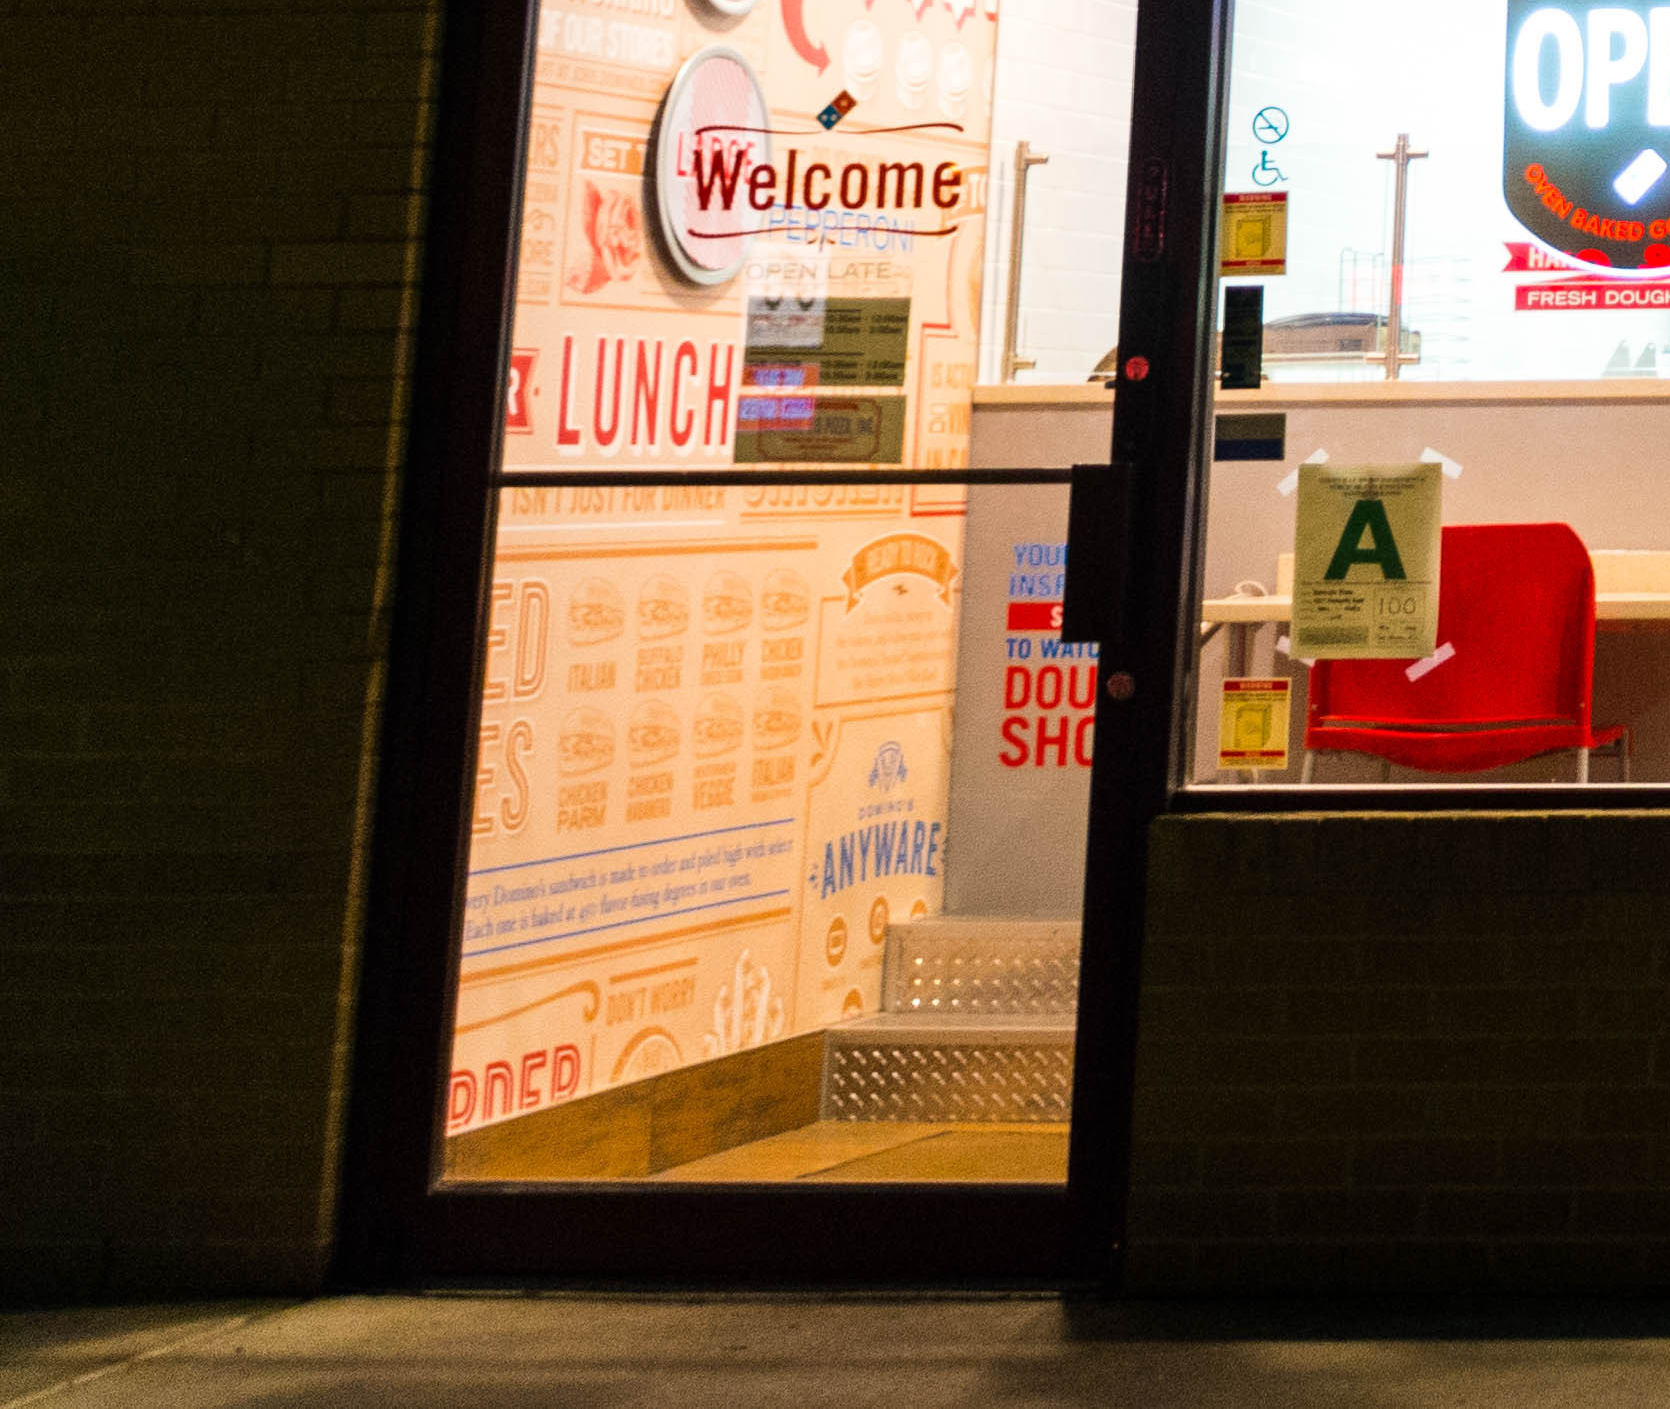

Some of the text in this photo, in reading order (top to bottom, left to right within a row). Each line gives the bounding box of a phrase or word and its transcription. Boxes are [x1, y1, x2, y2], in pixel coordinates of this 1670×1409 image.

[588, 140, 632, 173] SET
[694, 148, 963, 212] Welcome
[1523, 162, 1573, 220] OVEN
[1569, 205, 1645, 243] BAKED
[767, 203, 914, 253] PEPPERONI
[746, 261, 891, 280] OPEN LATE
[1527, 291, 1598, 306] FRESH
[556, 335, 735, 448] LUNCH
[1322, 499, 1408, 581] A
[1379, 596, 1418, 616] 100
[1006, 637, 1099, 659] TO WATC
[820, 820, 942, 899] ANYWARE
